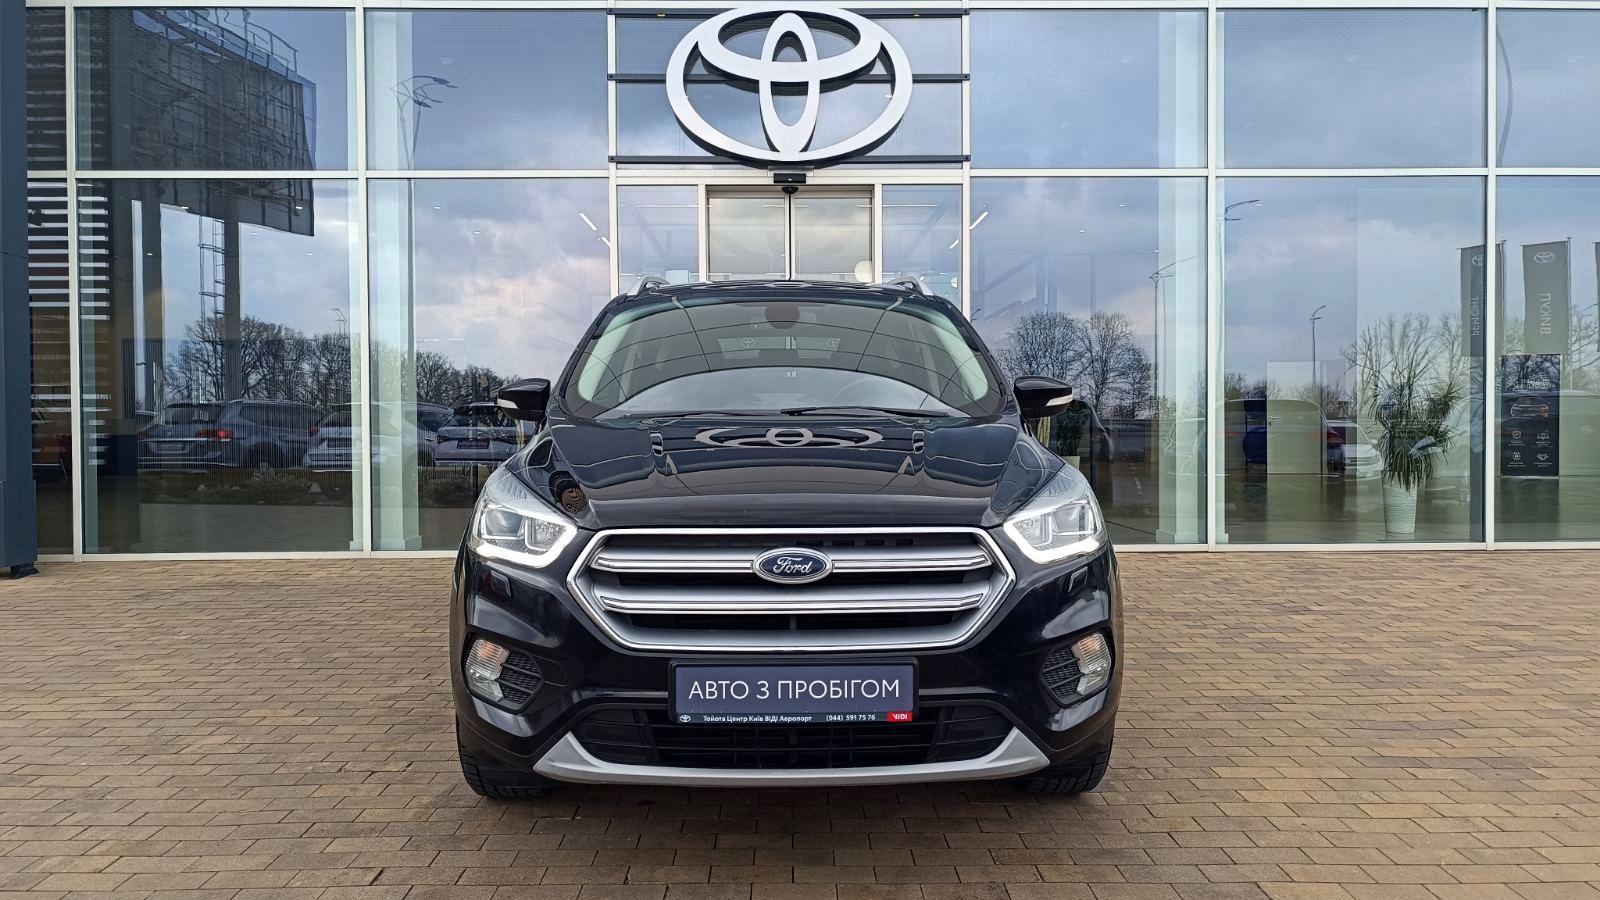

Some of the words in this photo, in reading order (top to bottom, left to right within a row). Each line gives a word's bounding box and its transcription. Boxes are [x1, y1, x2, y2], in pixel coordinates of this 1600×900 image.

[773, 557, 813, 573] Ford
[688, 680, 749, 700] АВТО
[778, 679, 900, 699] ПРОБІГОМ
[726, 715, 748, 723] Центр
[764, 715, 779, 723] ВІДІ
[779, 715, 813, 723] Аеропорт
[826, 714, 844, 722] (044)
